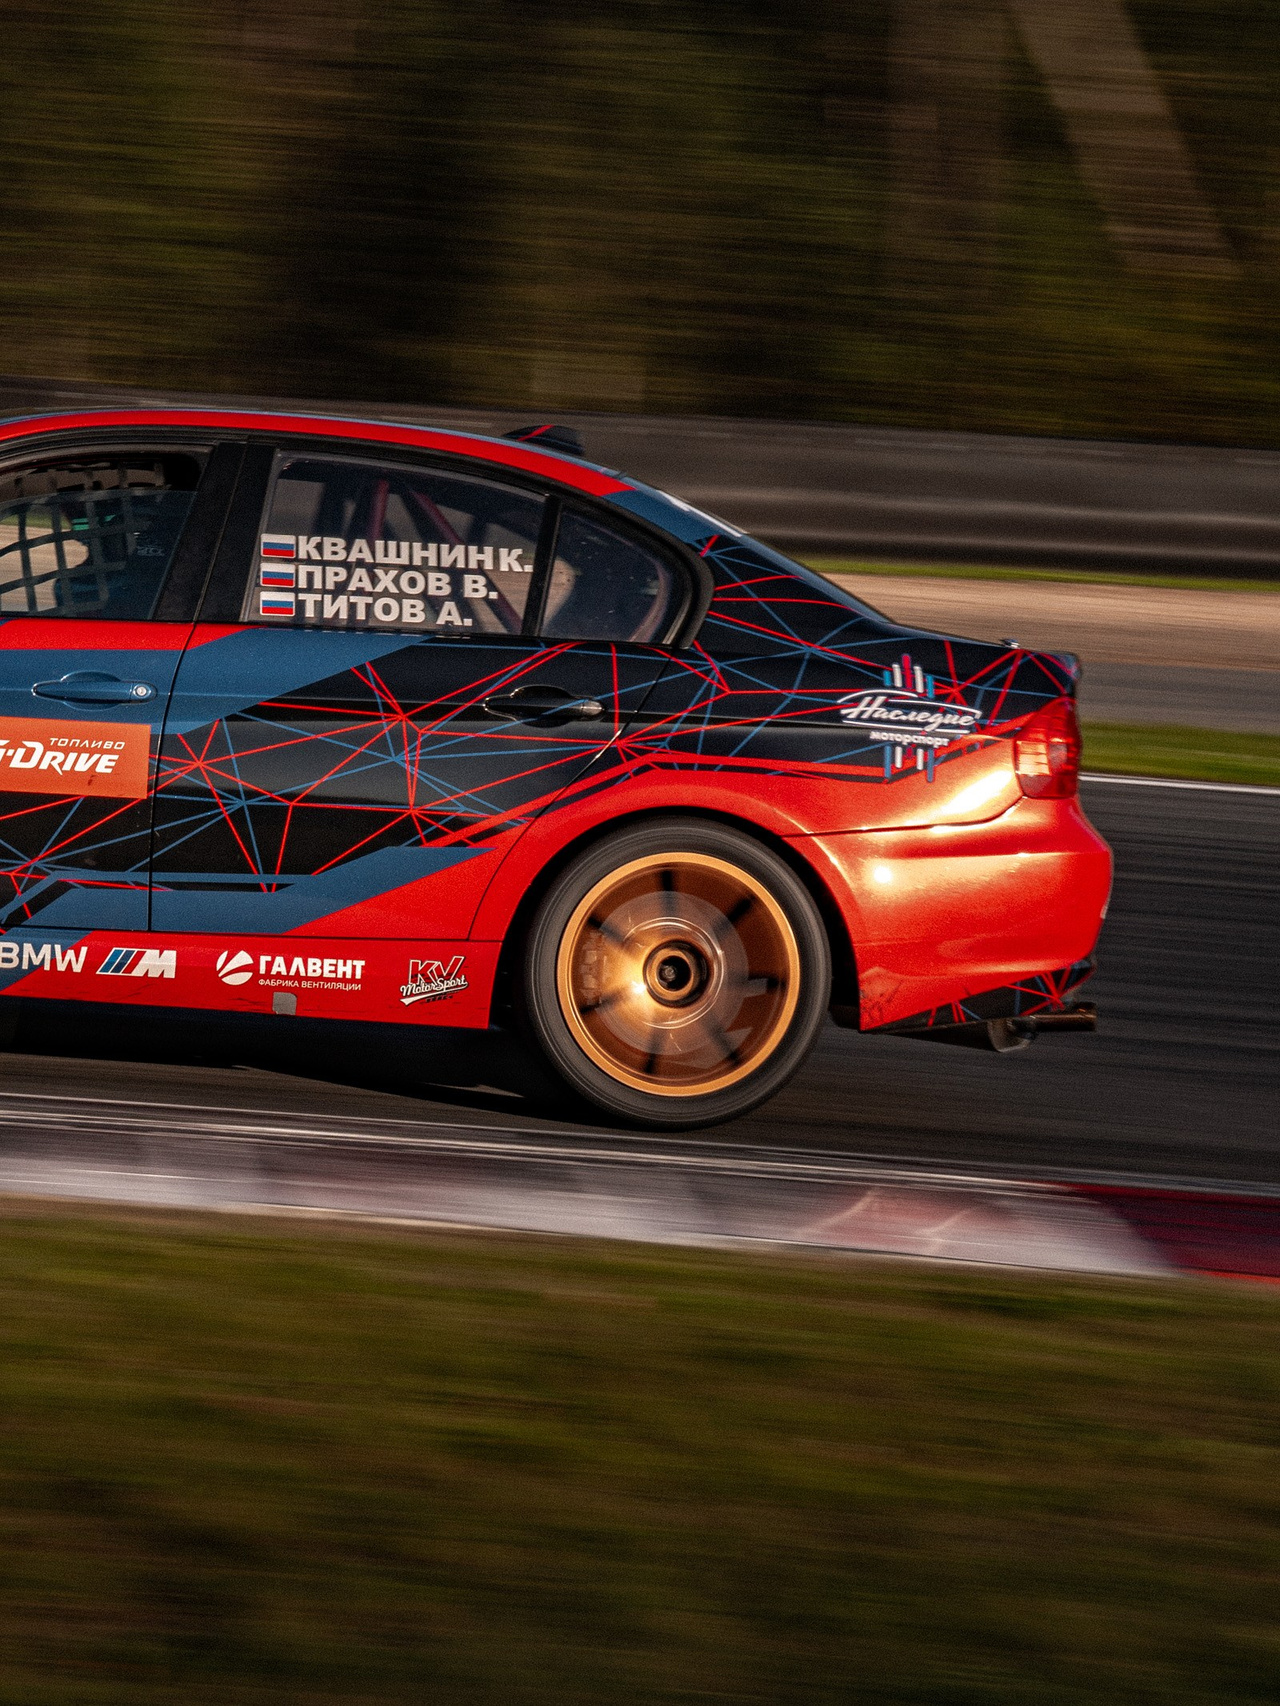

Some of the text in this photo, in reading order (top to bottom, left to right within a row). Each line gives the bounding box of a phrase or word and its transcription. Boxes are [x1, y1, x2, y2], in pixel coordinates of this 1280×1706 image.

[296, 535, 534, 572] КВАШНИН К.
[297, 564, 499, 599] ПРАХОВ В.
[297, 593, 473, 626] ТИТОВ А.
[840, 696, 976, 732] Наследие
[259, 955, 365, 979] ГАЛВЕНТ
[409, 955, 465, 985] KV
[258, 979, 362, 991] ФАБРИКА ВЕНТИЛЯЦИИ
